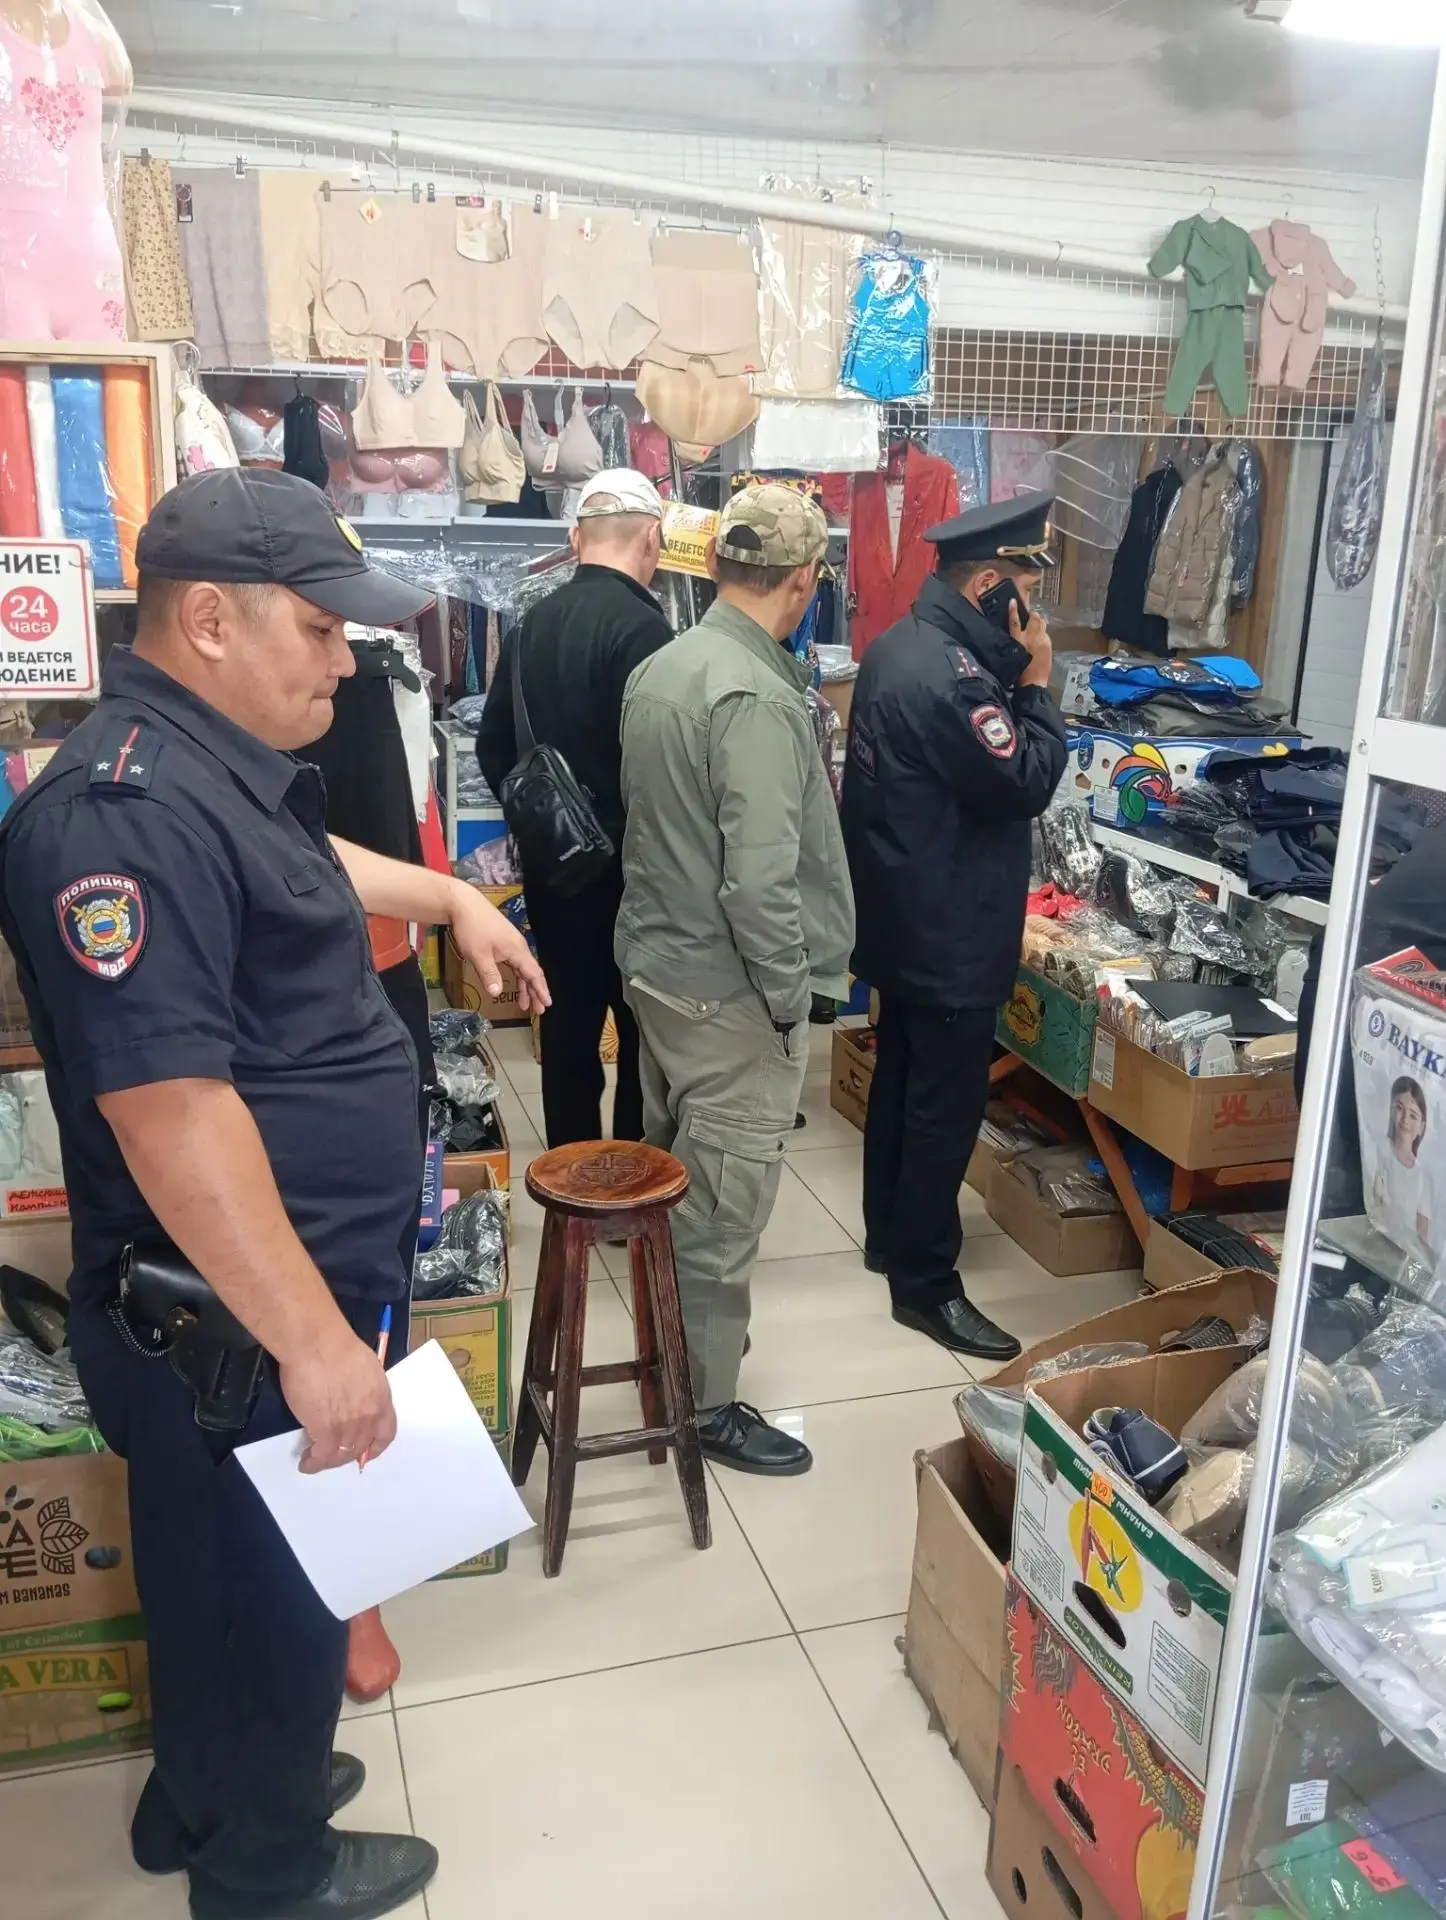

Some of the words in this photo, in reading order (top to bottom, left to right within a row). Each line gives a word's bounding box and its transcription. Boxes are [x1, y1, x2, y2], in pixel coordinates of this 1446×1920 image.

[668, 538, 707, 556] ВЕДЕТС
[10, 594, 48, 619] 24
[9, 621, 52, 634] часа
[7, 652, 73, 664] ВЕДЕТСЯ
[61, 877, 135, 907] ПОЛИЦИЯ
[97, 956, 128, 977] МВД
[1388, 1023, 1446, 1078] BAYK
[1115, 1500, 1154, 1540] БАНАНЫ
[25, 1628, 85, 1648] Ecuador
[26, 1656, 118, 1685] VERA
